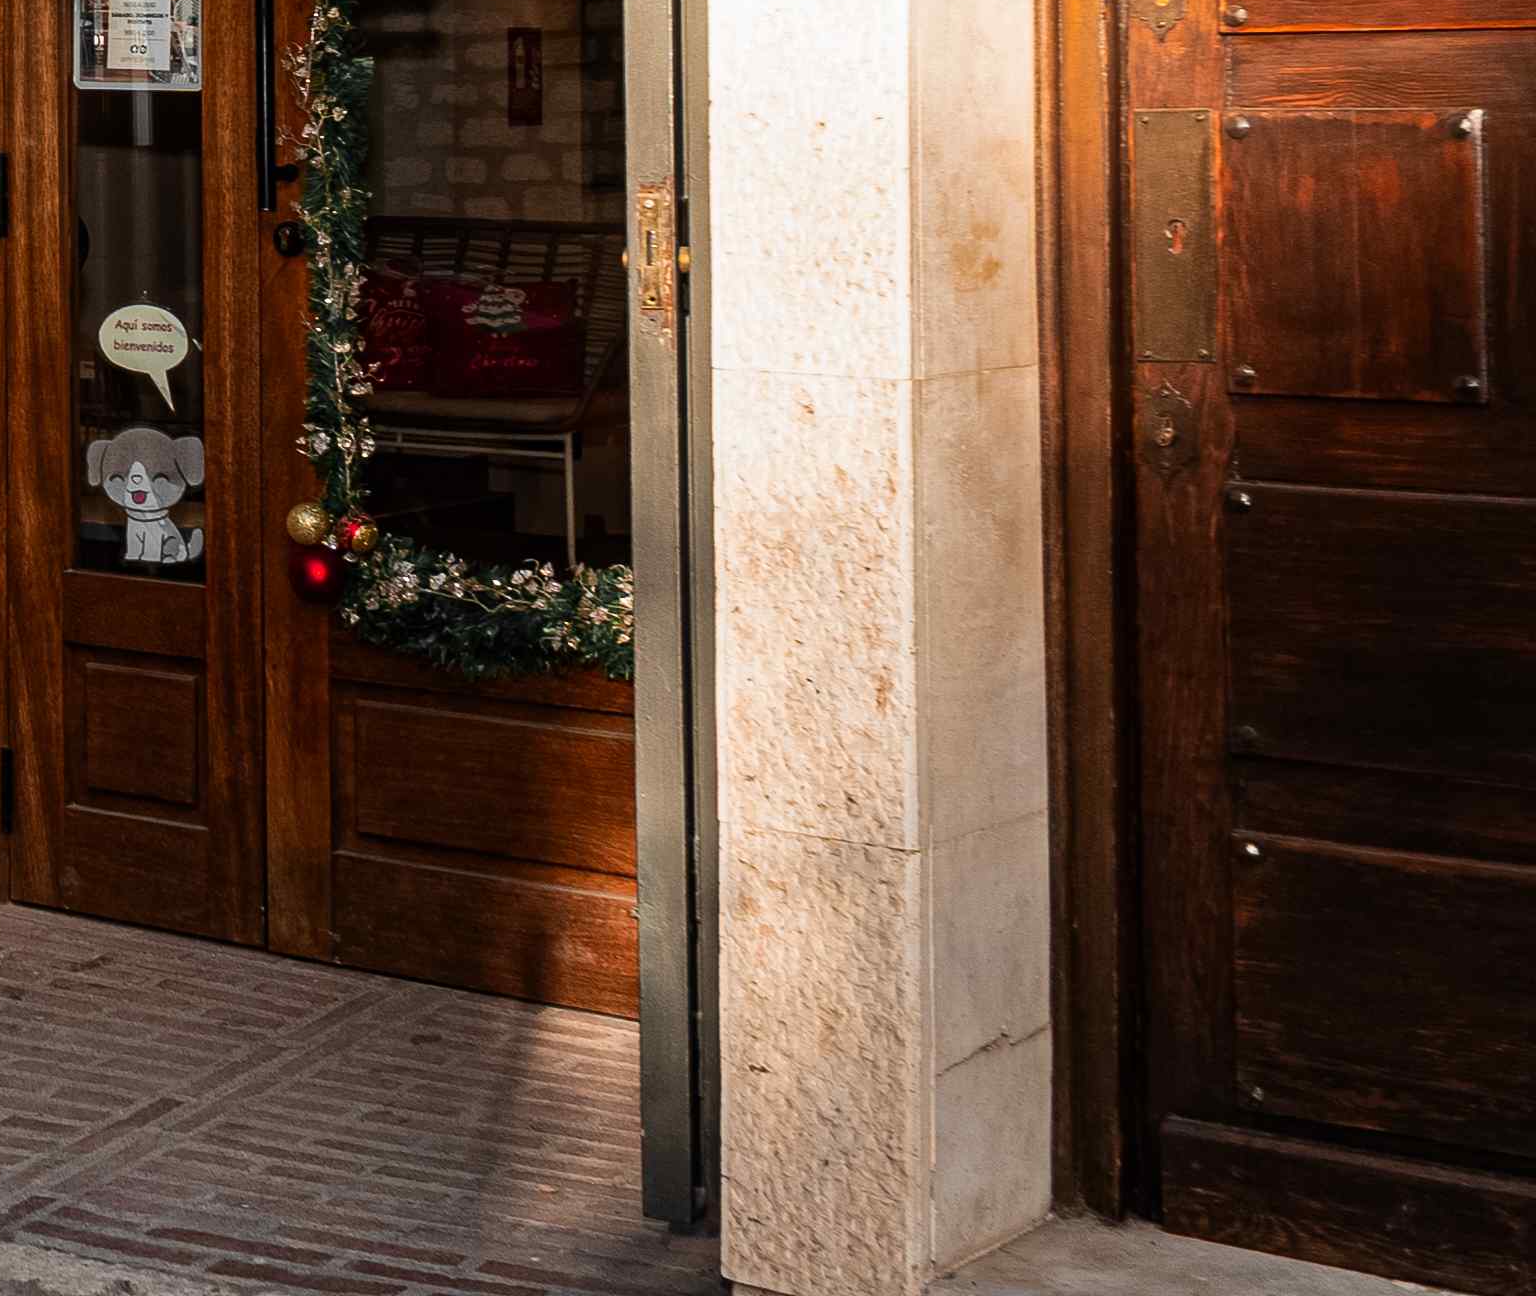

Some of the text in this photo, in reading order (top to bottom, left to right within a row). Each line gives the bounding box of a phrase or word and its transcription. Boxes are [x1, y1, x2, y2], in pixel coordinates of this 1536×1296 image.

[114, 319, 172, 333] Aquí somos
[113, 339, 175, 354] bienvenidos
